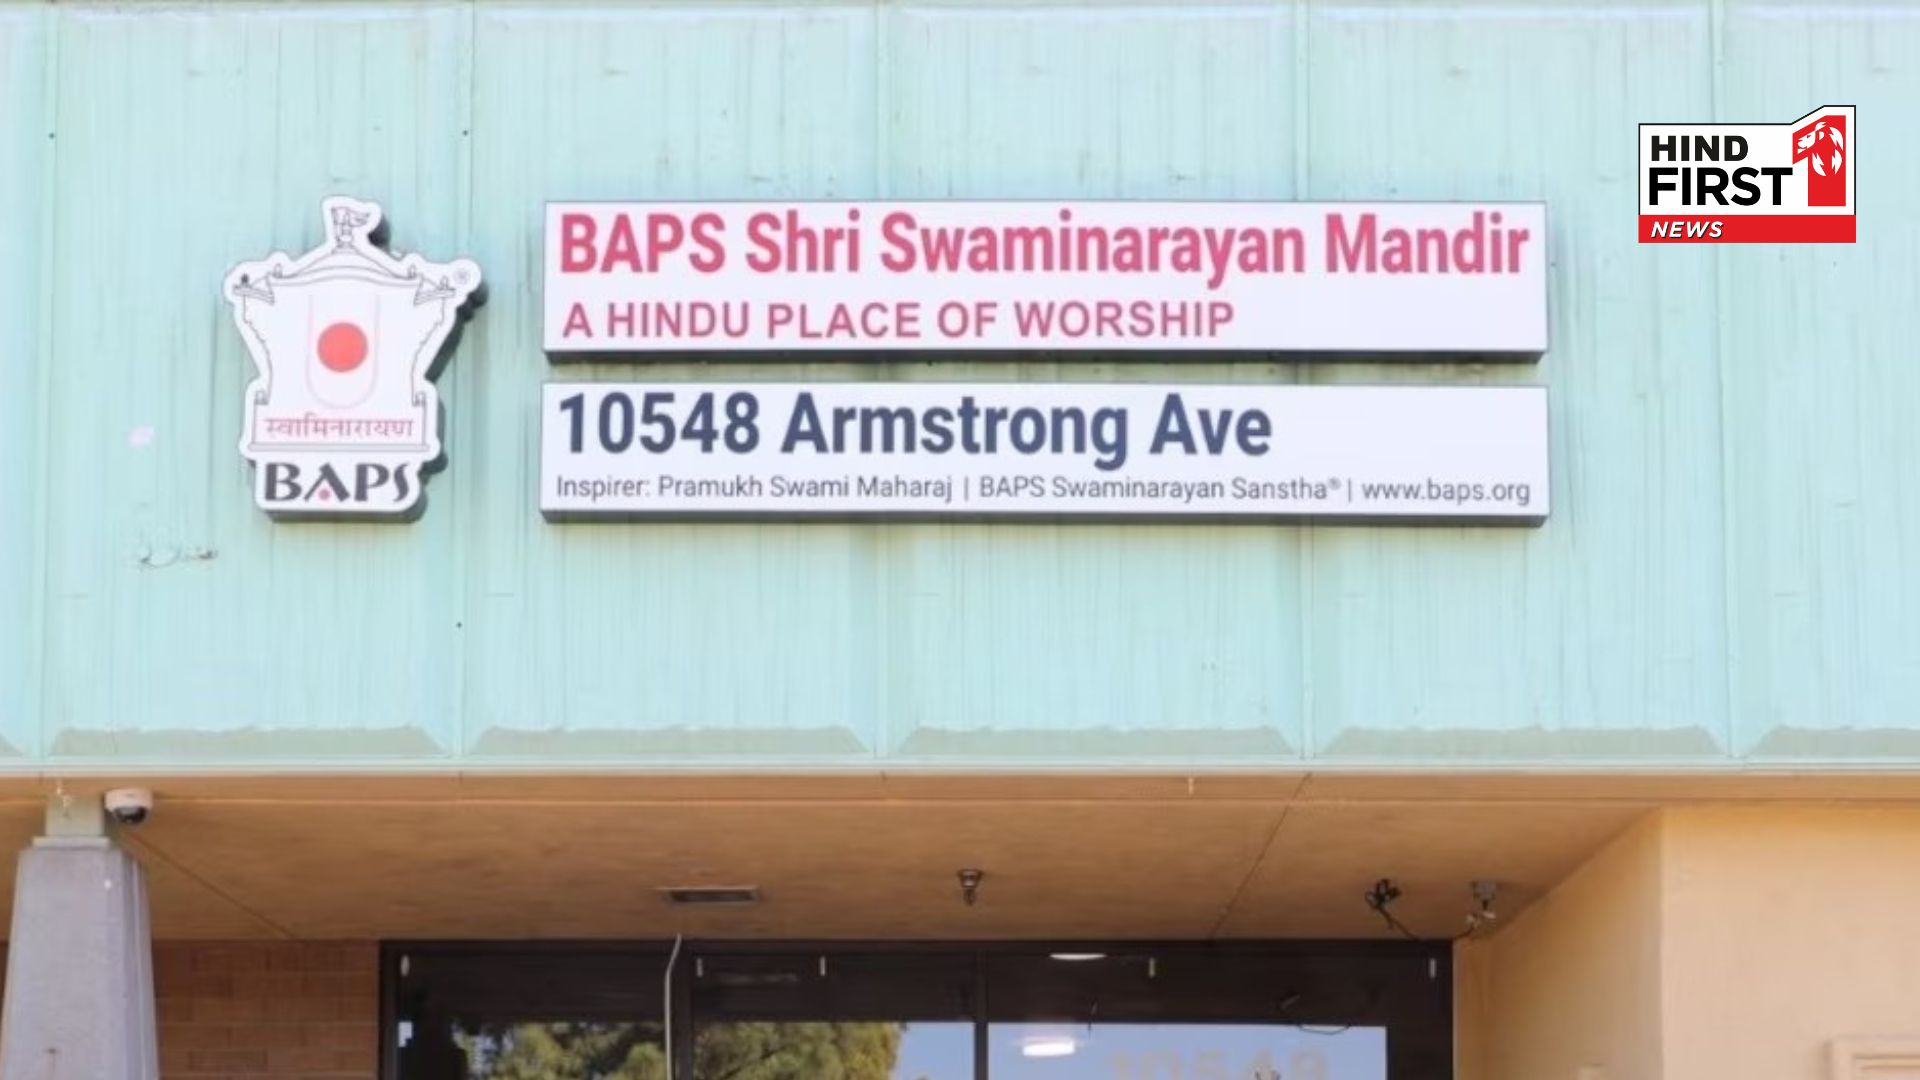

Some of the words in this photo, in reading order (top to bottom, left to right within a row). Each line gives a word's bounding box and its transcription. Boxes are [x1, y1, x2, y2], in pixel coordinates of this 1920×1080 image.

[561, 212, 726, 273] BAPS
[746, 208, 860, 273] Shri
[880, 208, 1305, 290] Swaminarayan
[1326, 211, 1530, 274] Mandir
[562, 301, 594, 339] A
[607, 301, 750, 339] HINDU
[768, 301, 921, 339] PLACE
[937, 301, 998, 339] OF
[1013, 300, 1235, 339] WORSHIP
[263, 411, 415, 438] स्वामिनारायण
[559, 392, 760, 455] 10548
[780, 392, 1129, 471] Armstrong
[1148, 393, 1273, 457] Ave
[264, 462, 410, 503] BAPS
[556, 475, 650, 502] Inspirer:
[659, 475, 763, 498] Pramukh
[770, 475, 849, 498] Swami
[856, 475, 953, 504] Maharaj
[979, 475, 1046, 498] BAPS
[1052, 475, 1225, 504] Swaminarayan
[1361, 477, 1531, 507] www.baps.org
